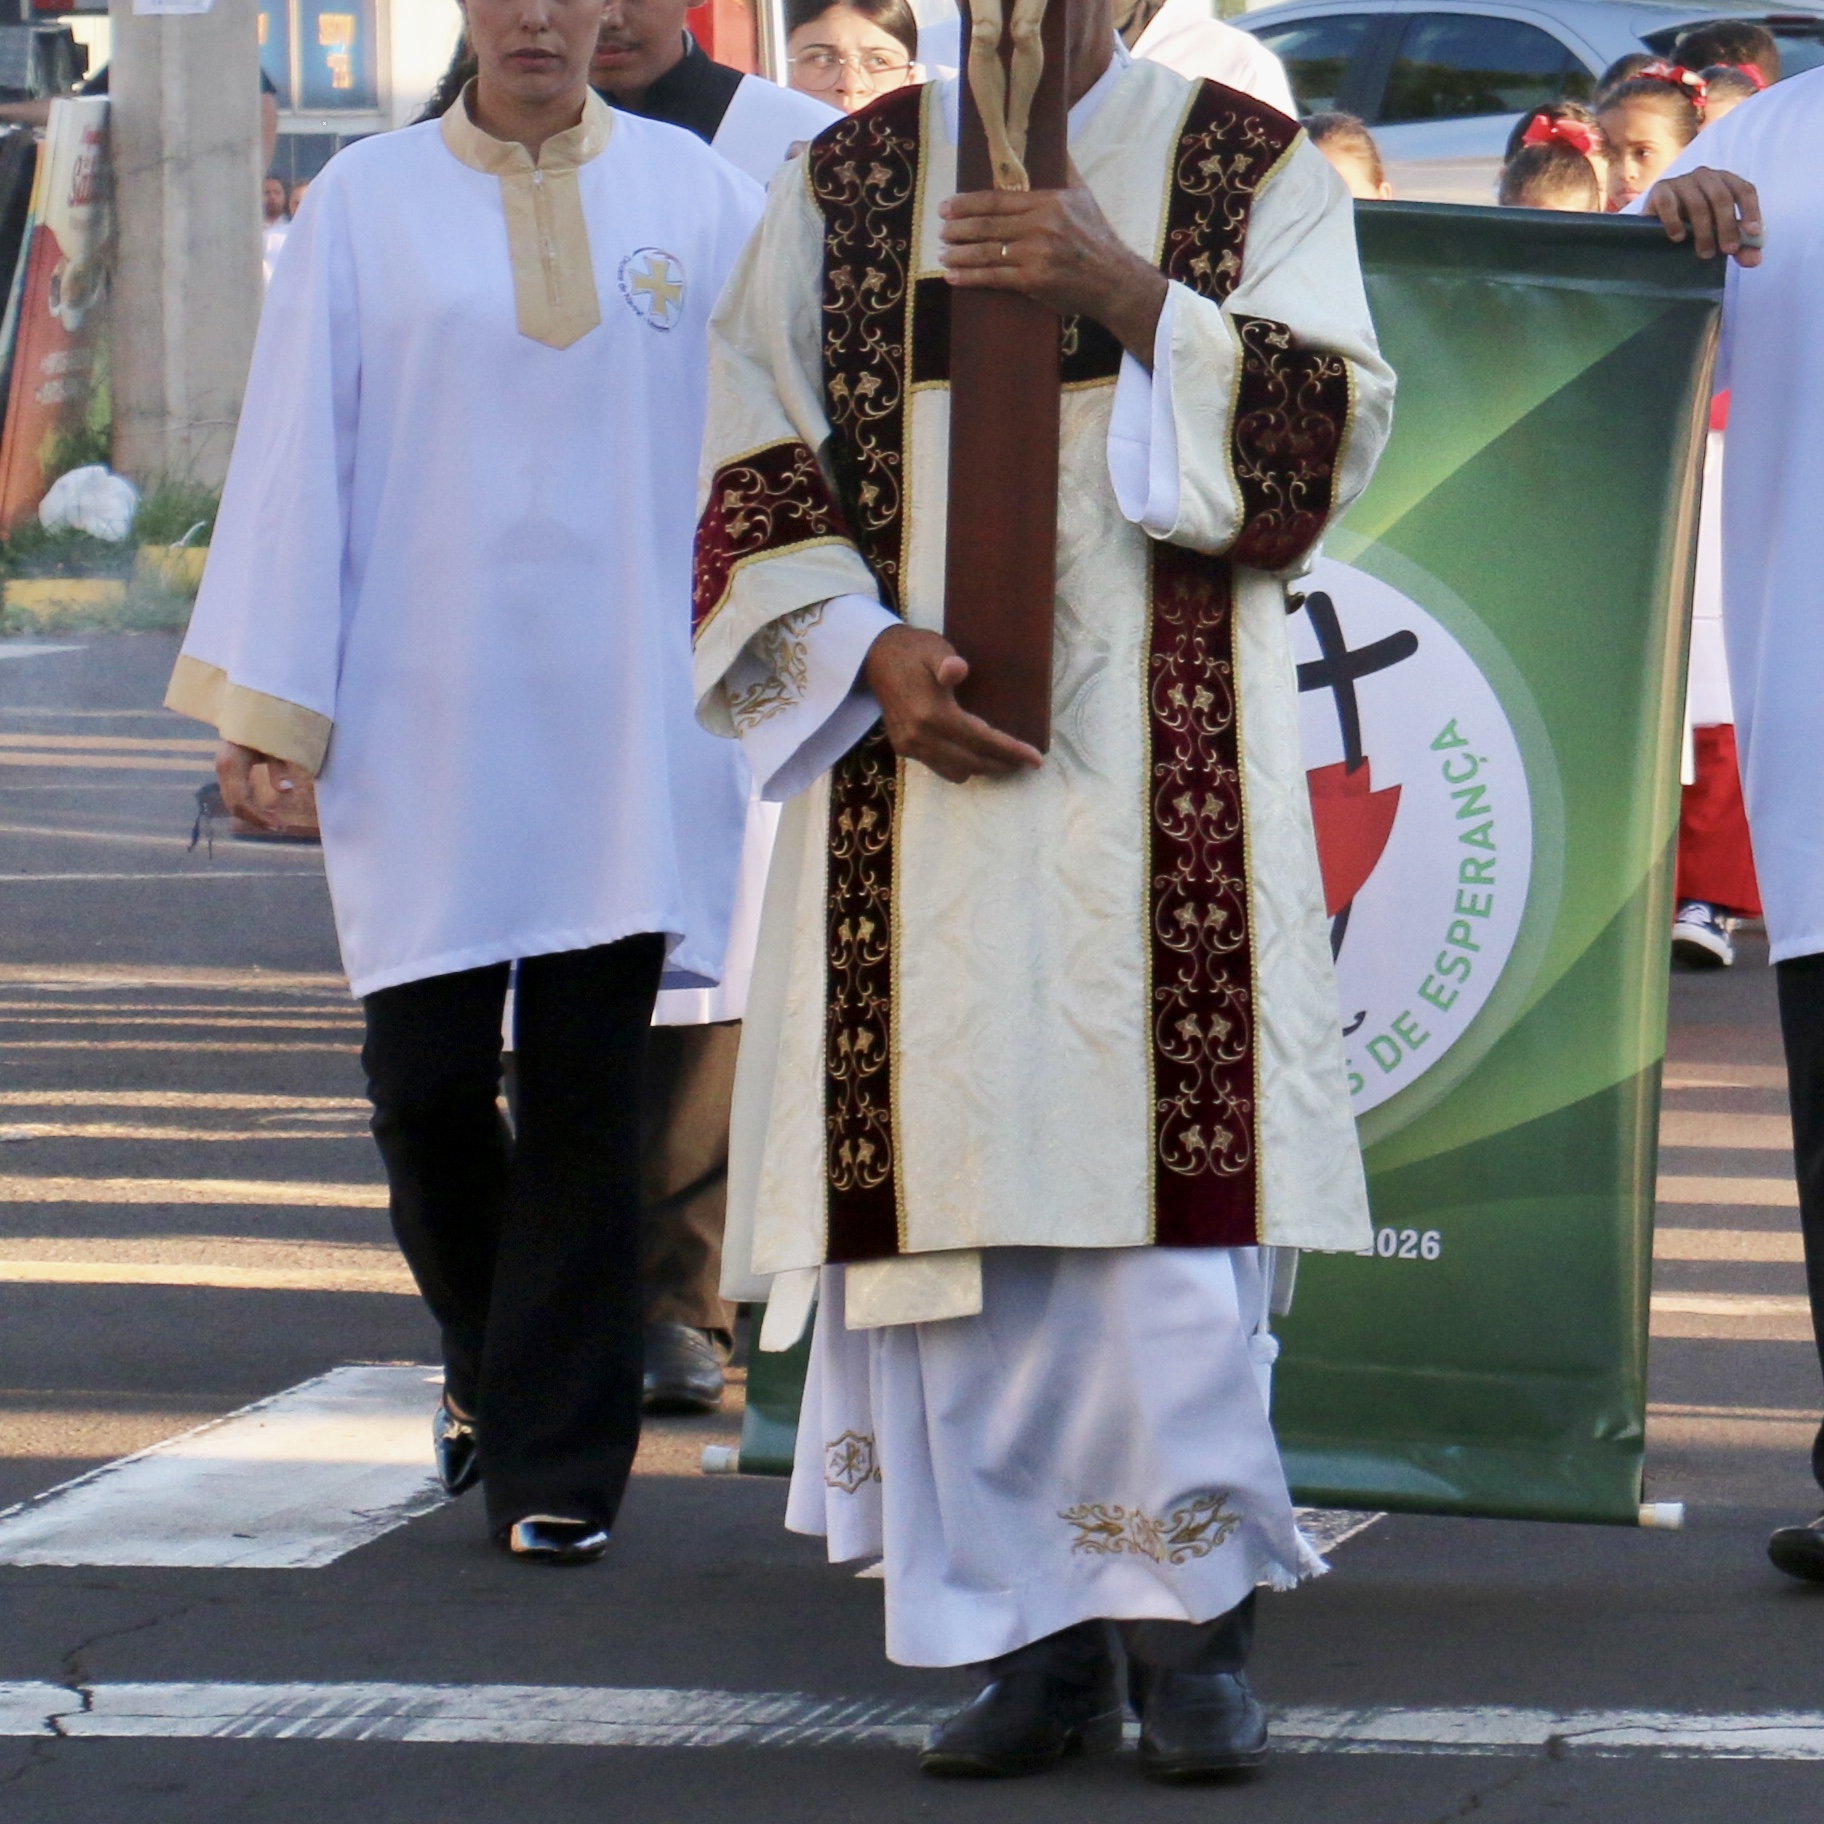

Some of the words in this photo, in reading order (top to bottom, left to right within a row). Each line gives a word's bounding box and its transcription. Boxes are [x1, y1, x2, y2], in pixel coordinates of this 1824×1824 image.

[1366, 1009, 1430, 1074] DE
[1418, 718, 1497, 1012] ESPERANÇA
[1356, 1228, 1441, 1260] 026
